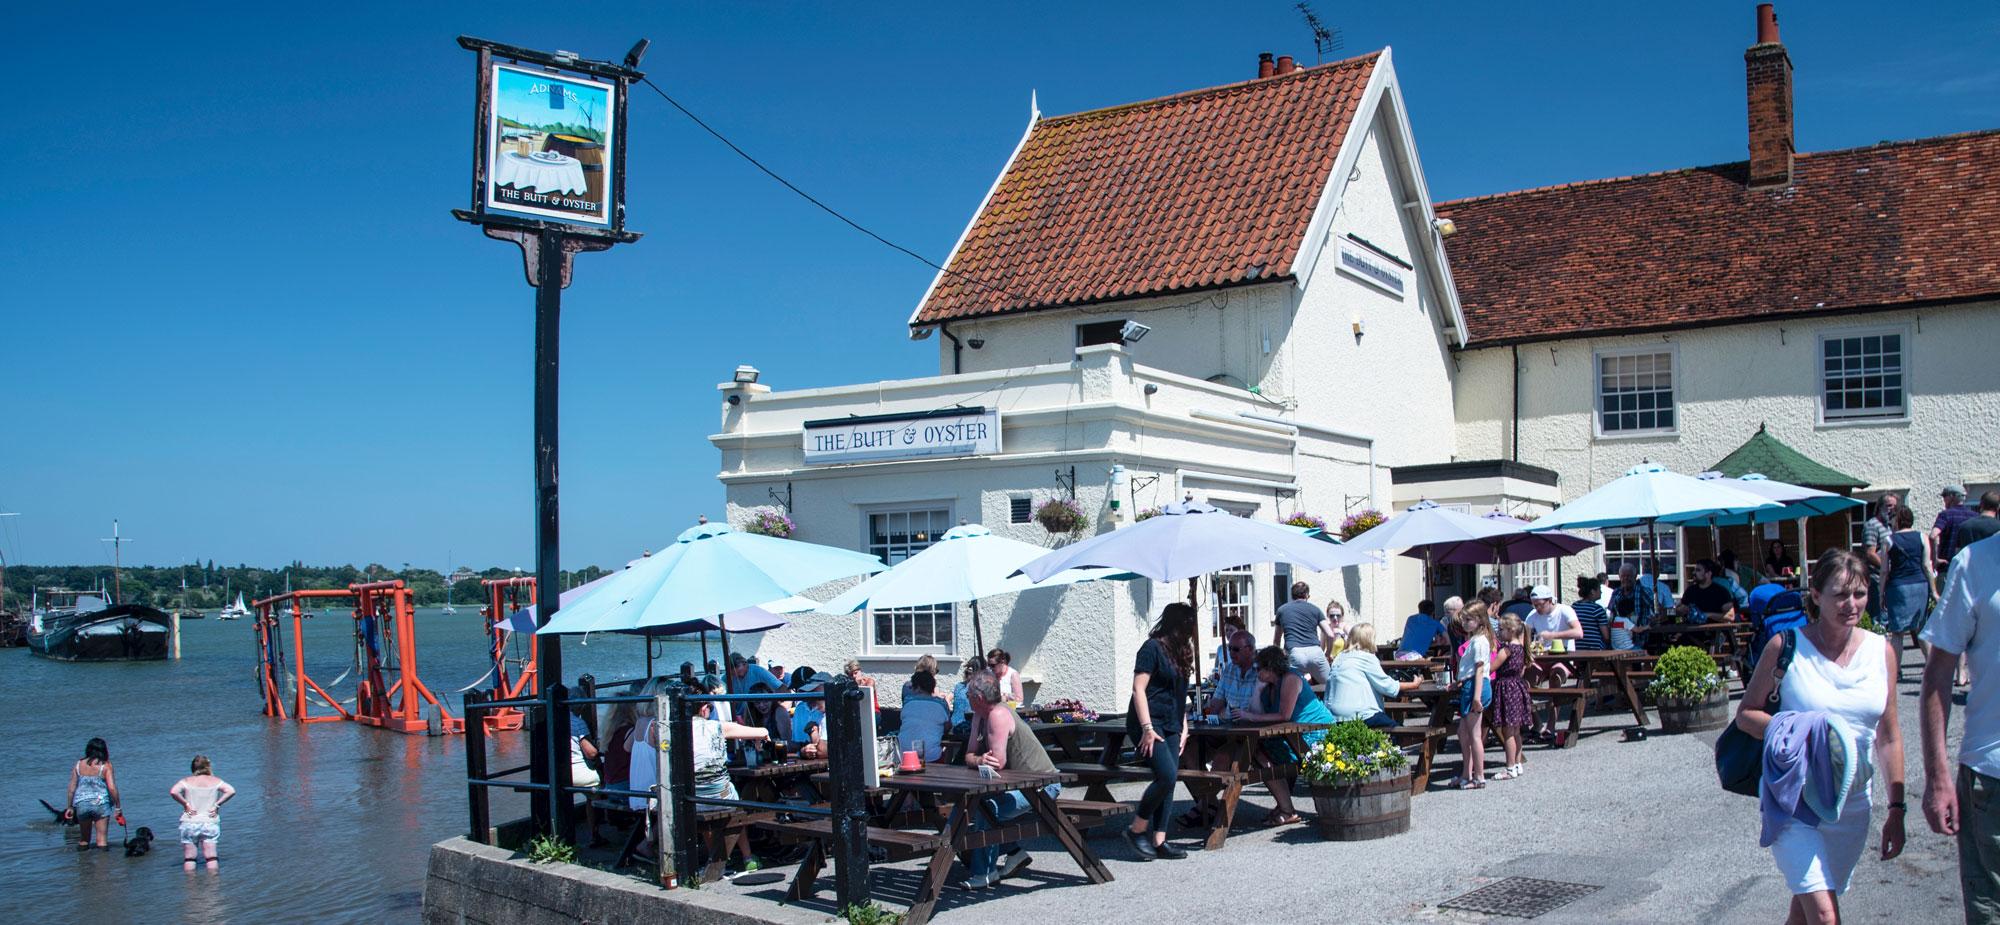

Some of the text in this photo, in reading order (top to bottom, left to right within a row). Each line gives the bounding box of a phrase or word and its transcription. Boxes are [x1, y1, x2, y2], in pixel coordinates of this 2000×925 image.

[529, 82, 577, 101] ADNAMS
[500, 188, 596, 211] THE BUTT & OYSTER
[815, 422, 987, 452] THE BUTT & OYSTER
